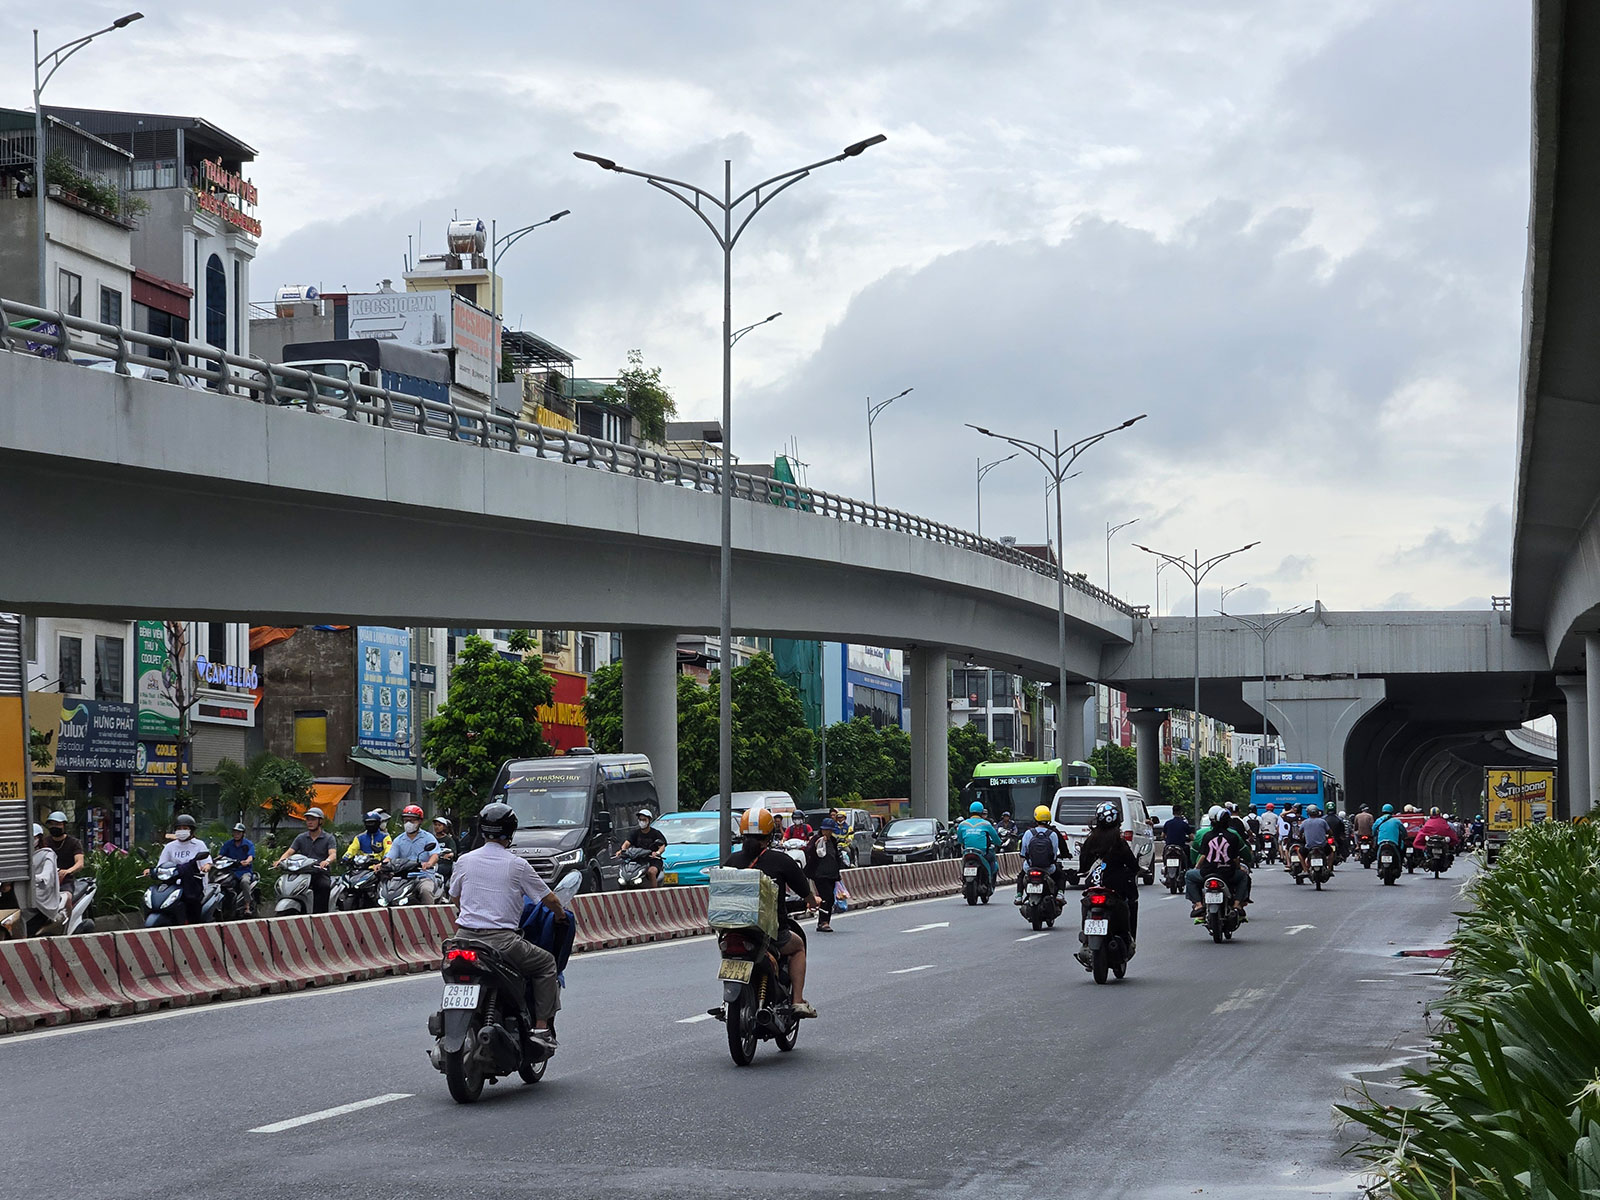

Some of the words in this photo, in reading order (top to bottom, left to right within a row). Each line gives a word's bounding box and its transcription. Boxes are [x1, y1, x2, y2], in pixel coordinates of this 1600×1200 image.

[352, 296, 436, 315] KCCSHOP.VN
[455, 303, 501, 348] KCCSHOP.N
[141, 654, 161, 665] COOLPET
[93, 714, 115, 729] HƯNG
[115, 715, 135, 730] PHÁT
[70, 755, 85, 767] PHÂN
[86, 754, 99, 768] PHỐI
[100, 757, 112, 768] SƠN
[115, 757, 126, 769] SÀN
[127, 755, 135, 769] GỖ
[448, 986, 474, 996] 29-H1
[443, 997, 475, 1007] 848.04
